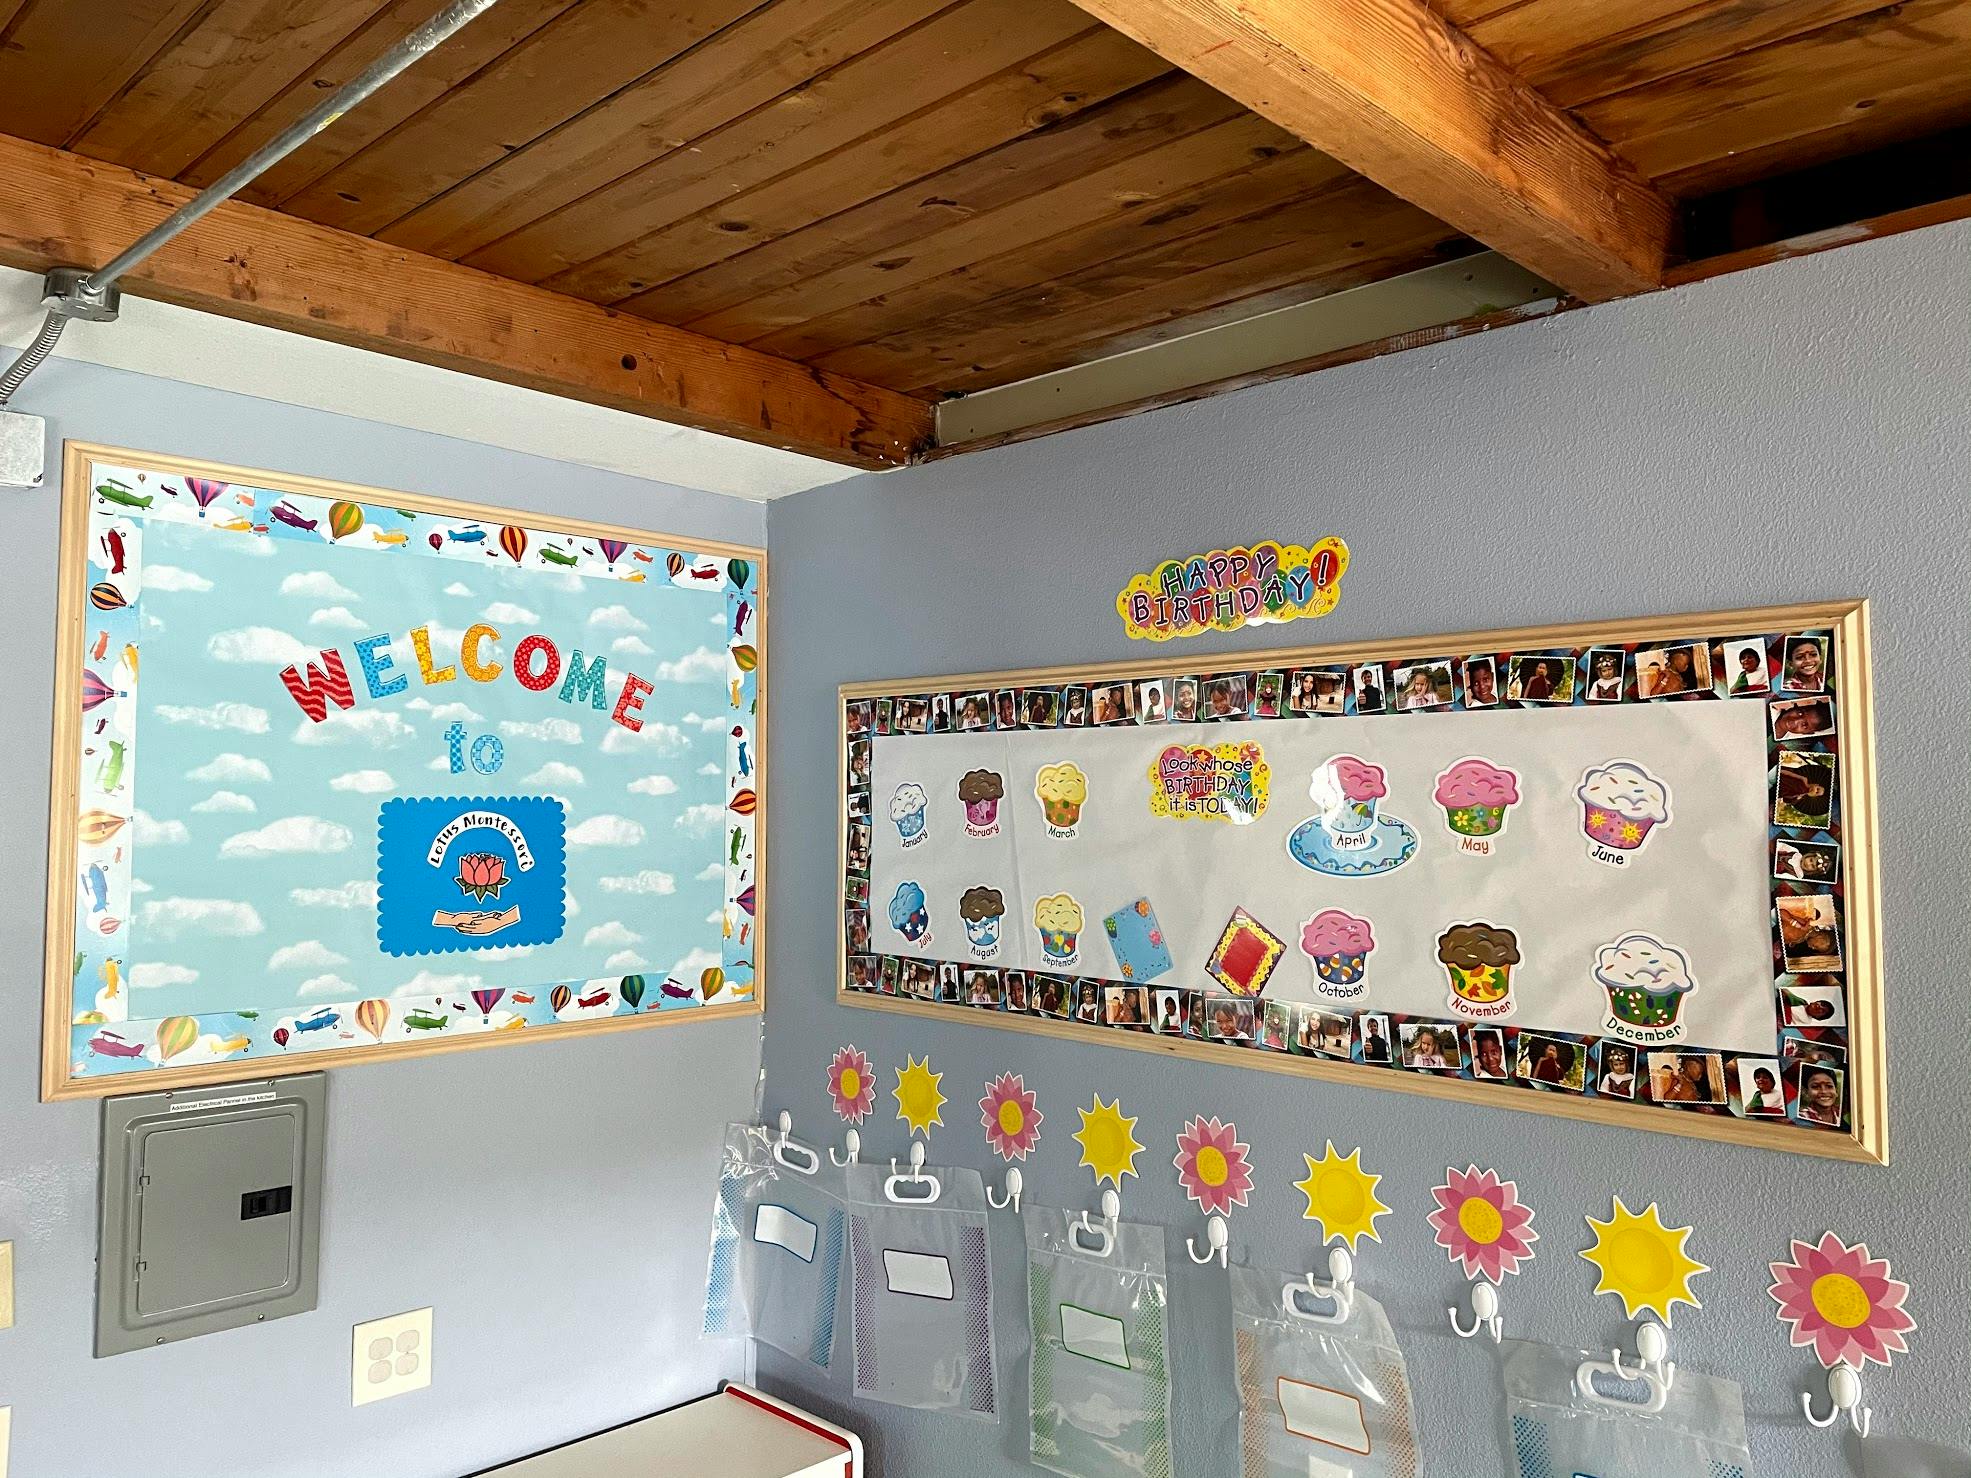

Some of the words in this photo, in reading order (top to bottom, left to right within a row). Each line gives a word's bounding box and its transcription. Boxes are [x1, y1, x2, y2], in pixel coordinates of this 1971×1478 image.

[1163, 552, 1275, 599] HAPPY
[279, 623, 655, 733] WELCOME
[444, 721, 504, 775] to
[1162, 756, 1197, 776] Look
[1199, 756, 1253, 773] whose
[1165, 776, 1251, 796] BIRTHDAY
[1169, 798, 1181, 811] it
[1185, 798, 1197, 811] is
[901, 829, 929, 848] January
[964, 823, 1000, 837] February
[1048, 826, 1076, 838] March
[431, 824, 459, 864] Lotus
[463, 814, 533, 869] Montessori
[1336, 833, 1367, 847] April
[1461, 837, 1490, 854] May
[1591, 845, 1625, 866] June
[919, 931, 933, 949] July
[970, 944, 999, 960] August
[1042, 954, 1079, 968] September
[1318, 981, 1364, 998] October
[1451, 998, 1512, 1016] November
[1606, 1016, 1681, 1041] December
